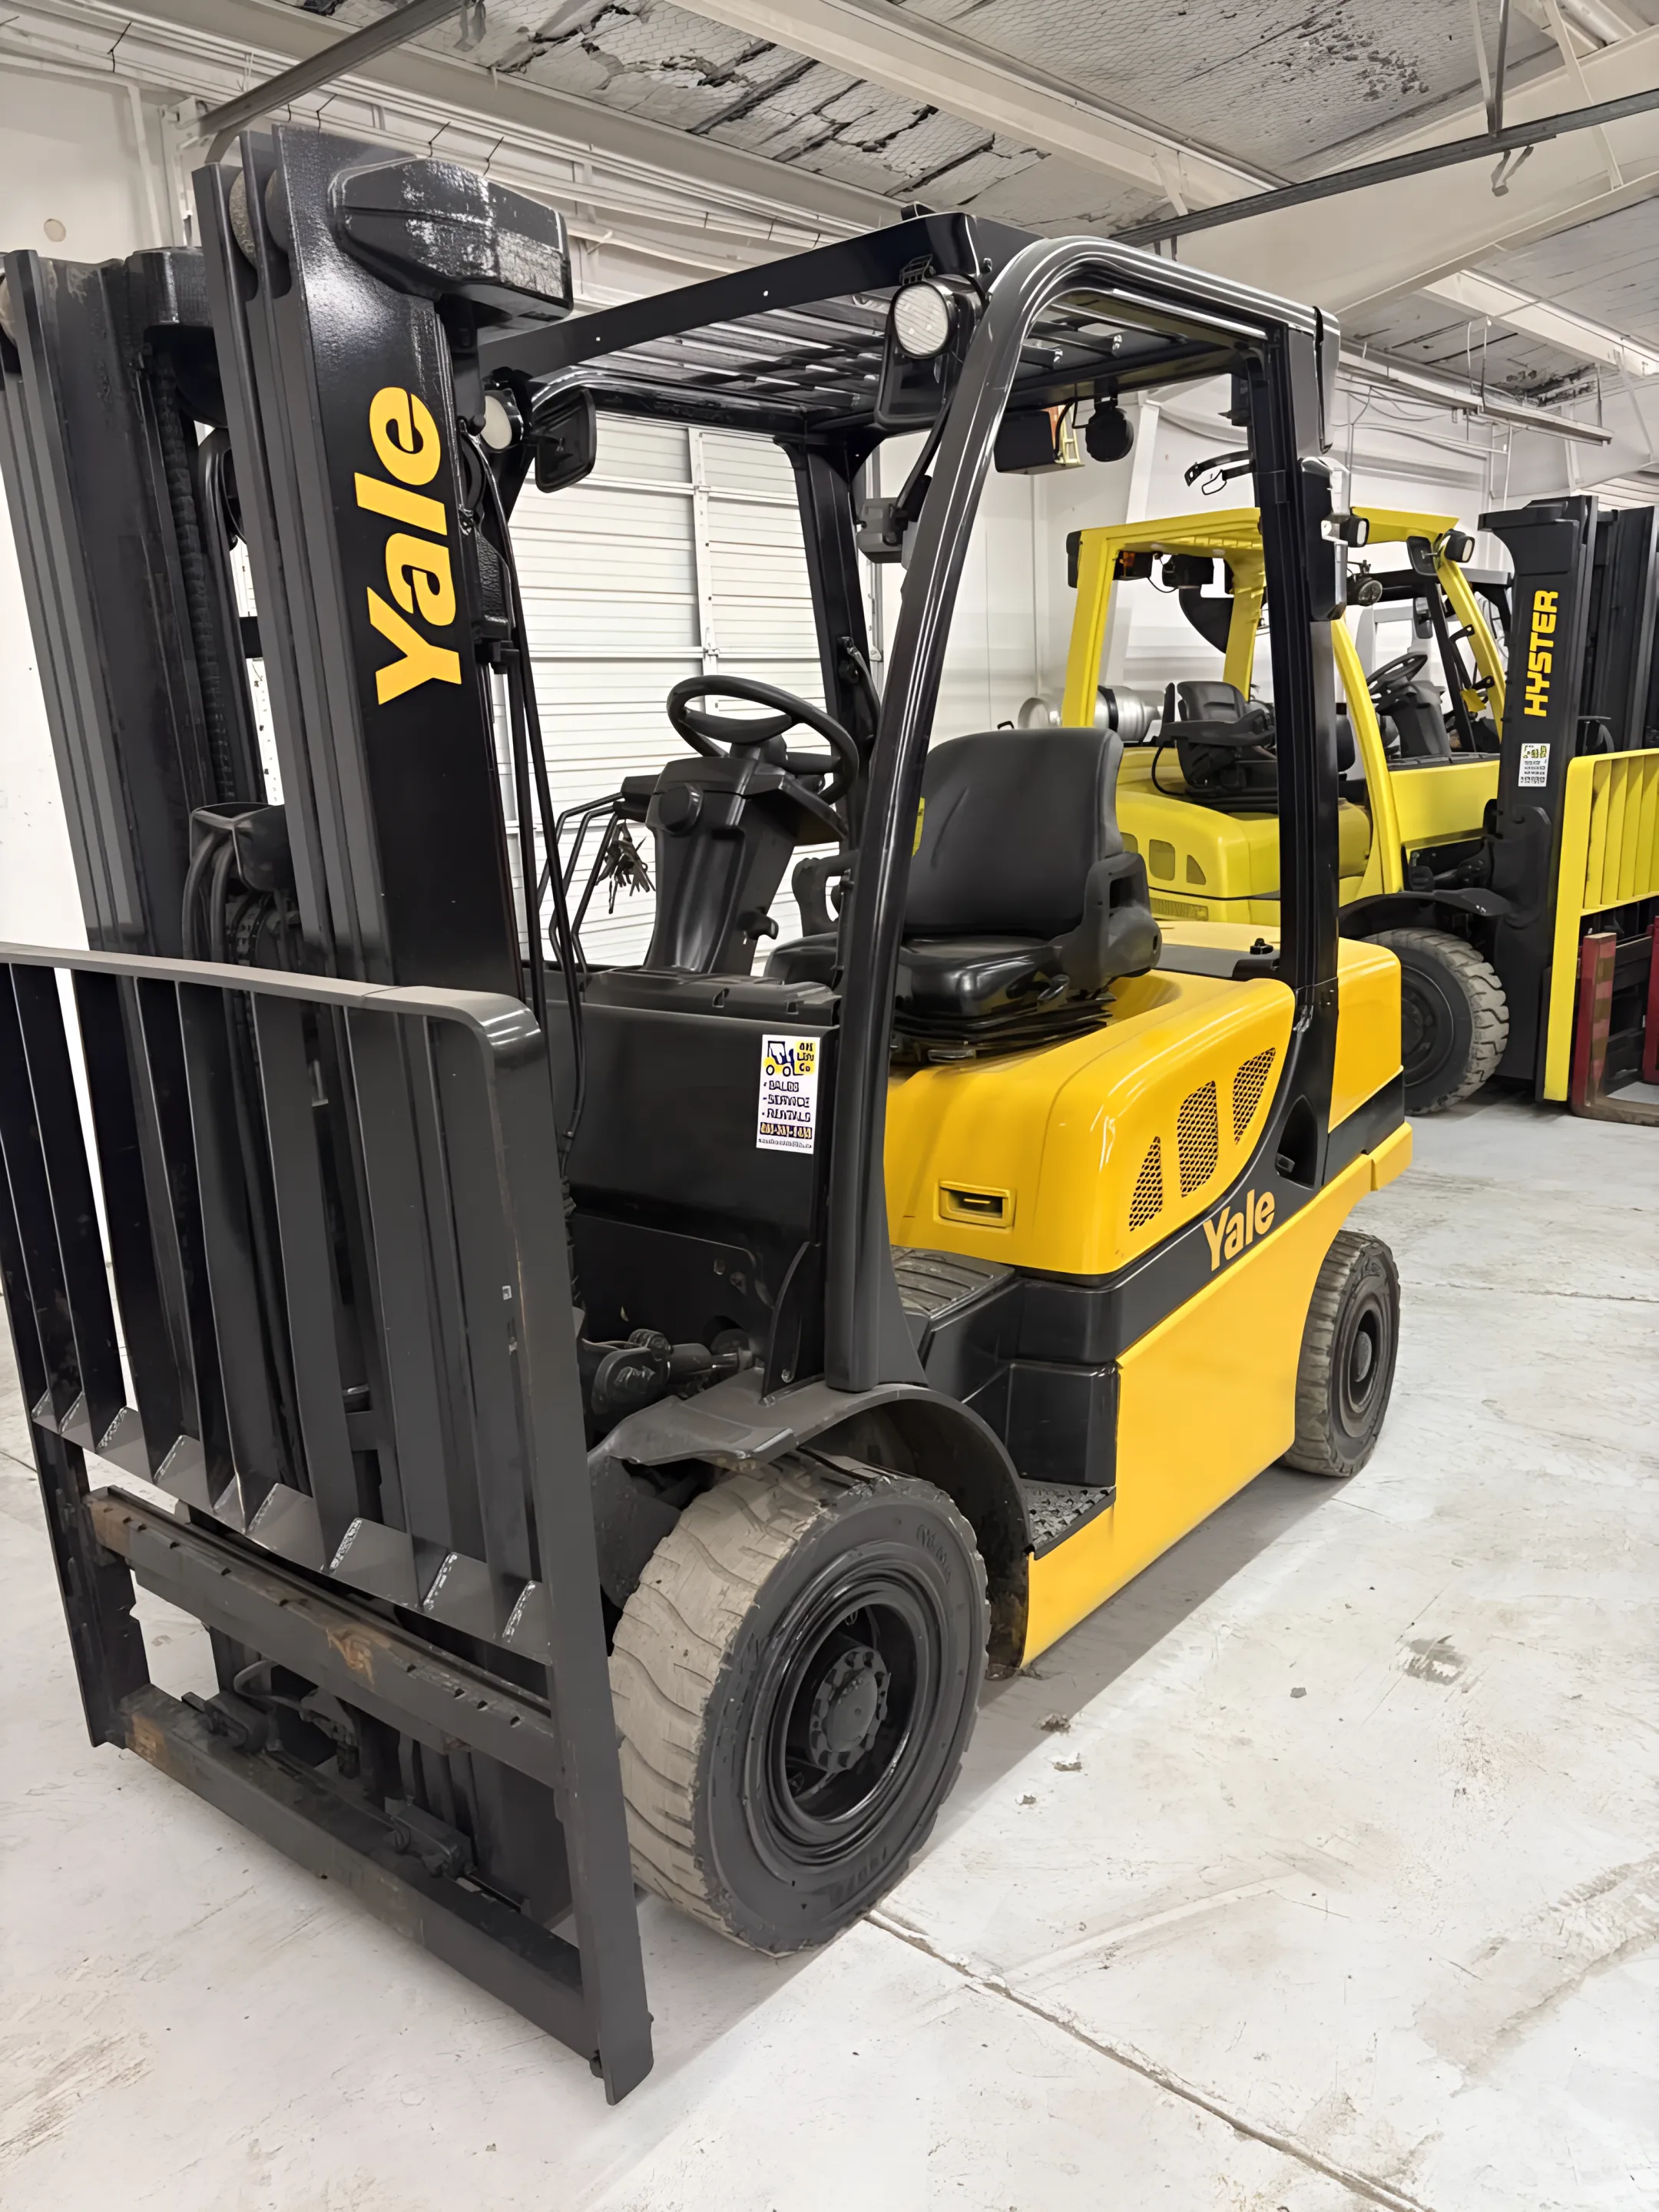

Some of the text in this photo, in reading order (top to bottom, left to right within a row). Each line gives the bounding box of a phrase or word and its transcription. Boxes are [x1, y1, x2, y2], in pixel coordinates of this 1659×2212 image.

[354, 386, 462, 705] Yale
[1524, 590, 1558, 717] HYSTER
[1203, 1189, 1275, 1272] Yale
